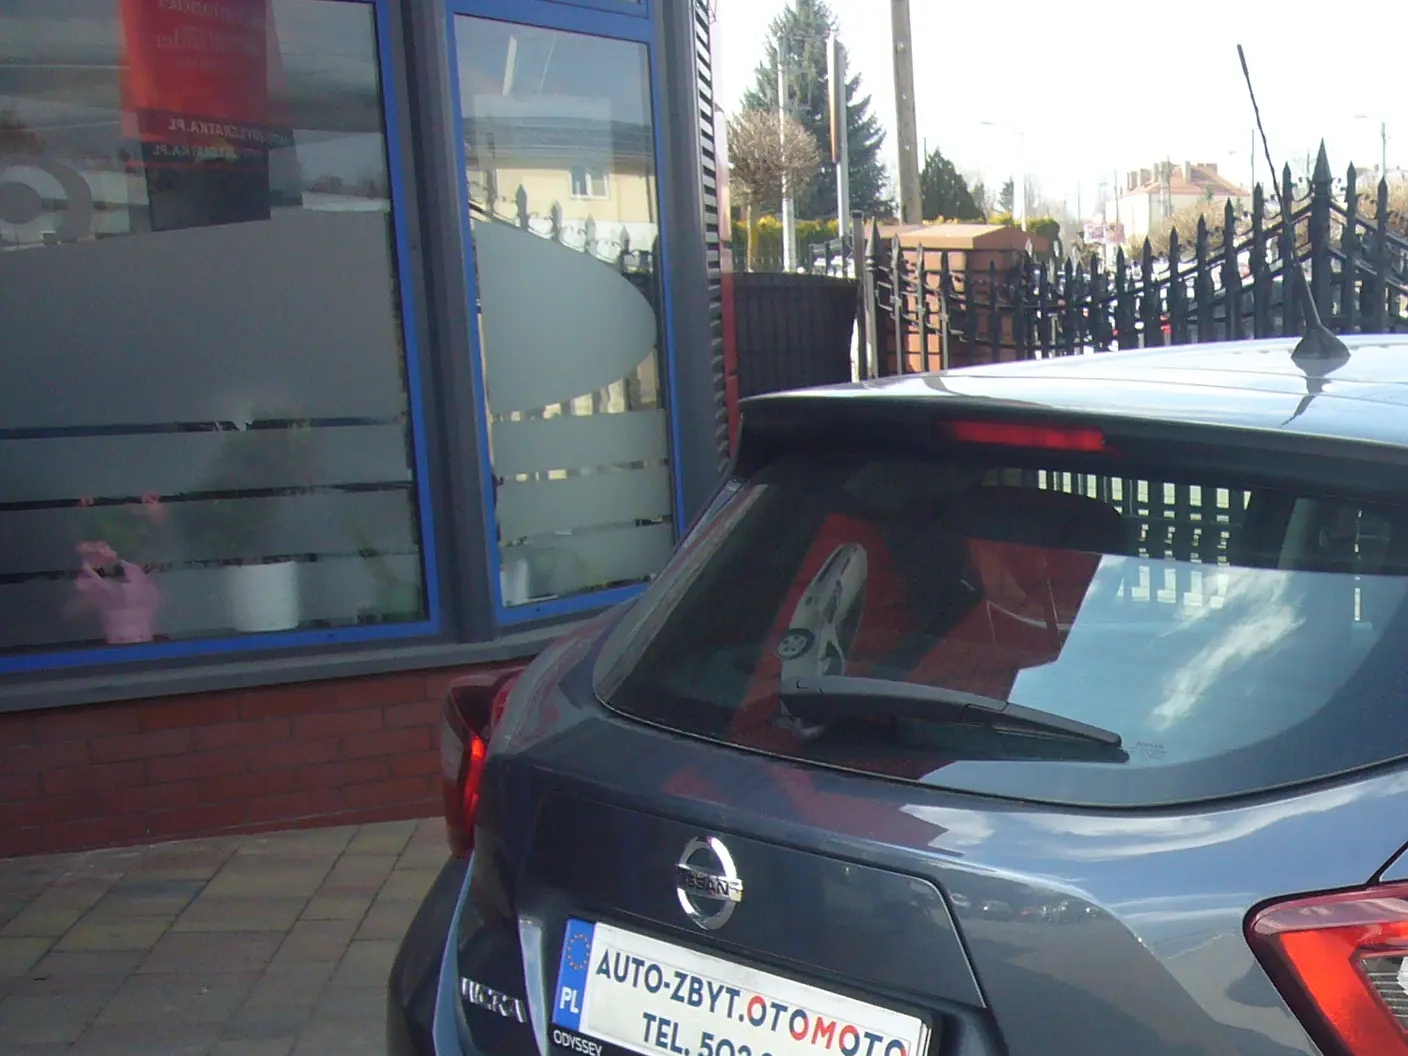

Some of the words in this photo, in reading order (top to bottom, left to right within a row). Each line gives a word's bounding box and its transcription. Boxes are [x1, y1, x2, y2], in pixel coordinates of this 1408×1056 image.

[682, 867, 730, 896] ISSAN
[560, 986, 580, 1013] PL
[643, 1012, 690, 1056] TEL.
